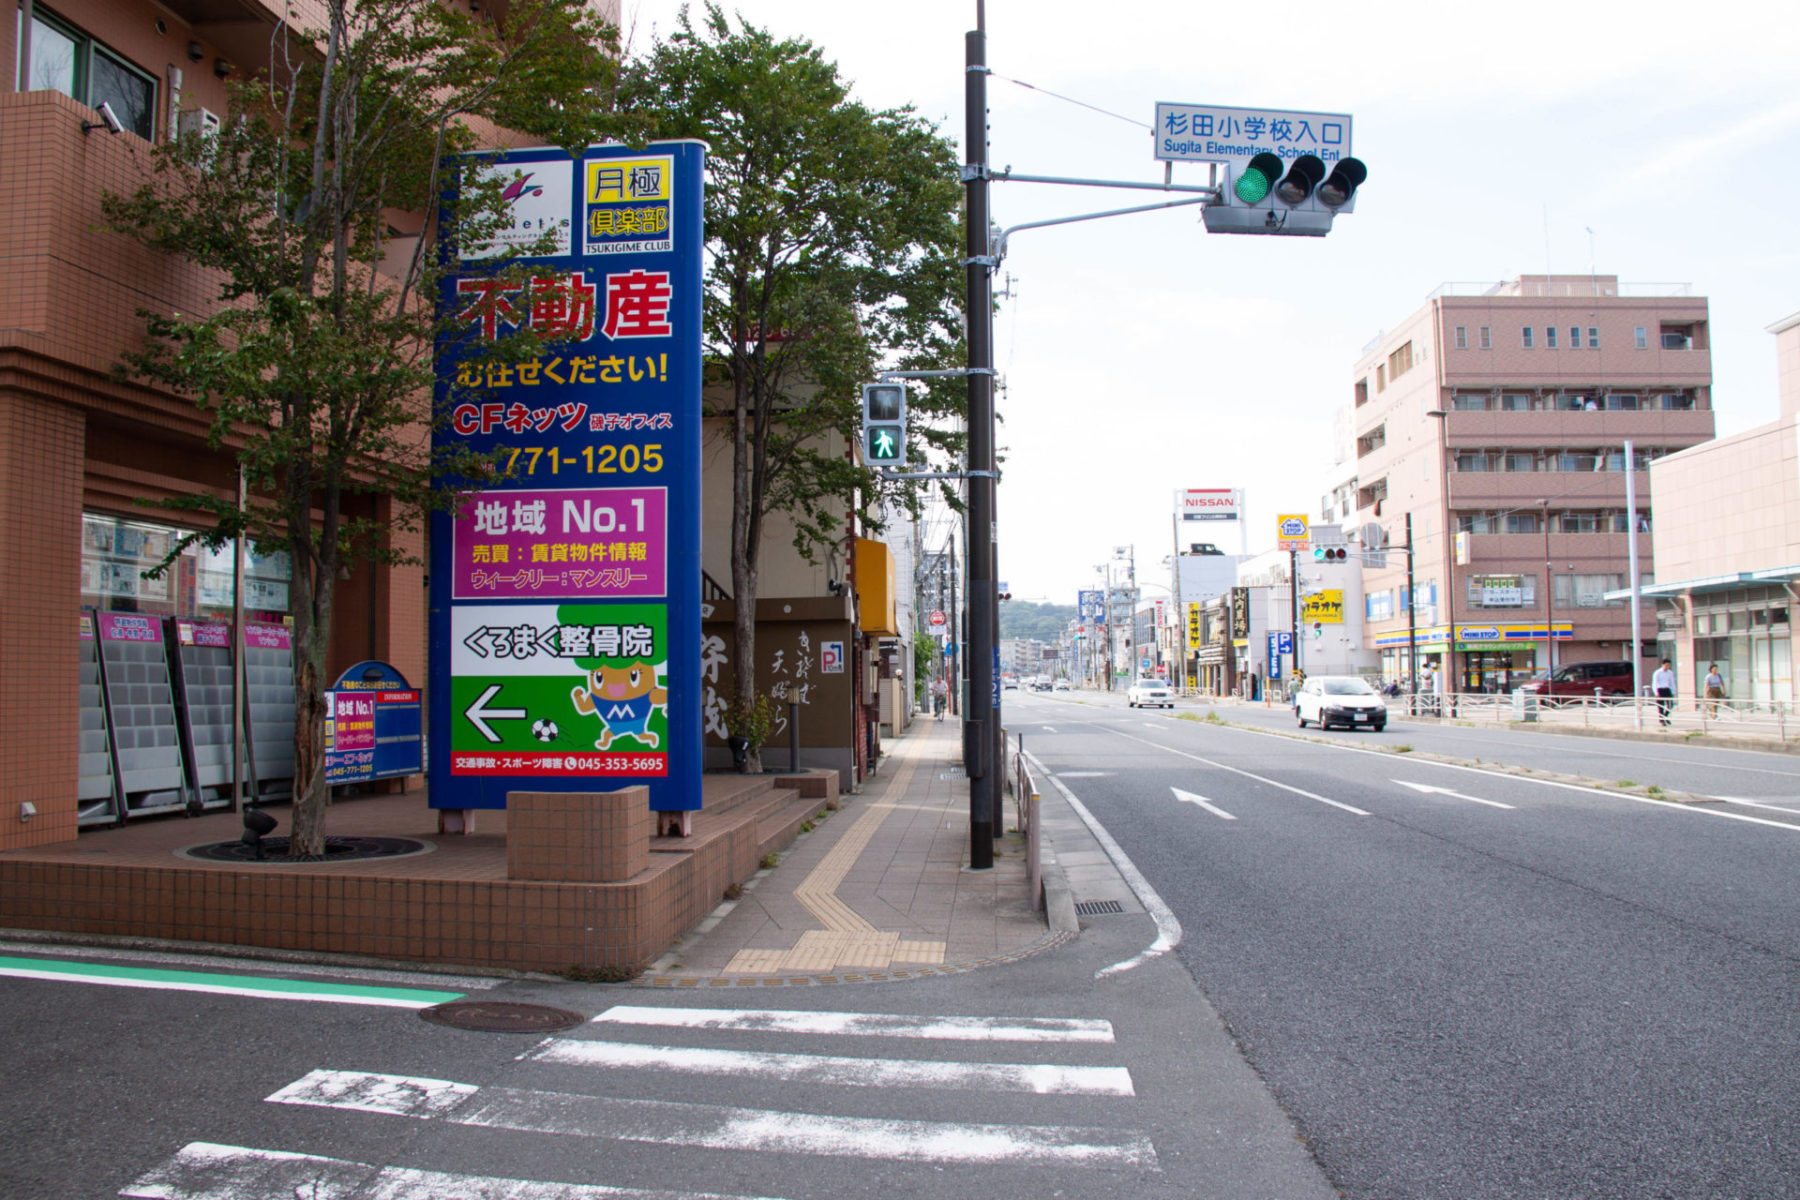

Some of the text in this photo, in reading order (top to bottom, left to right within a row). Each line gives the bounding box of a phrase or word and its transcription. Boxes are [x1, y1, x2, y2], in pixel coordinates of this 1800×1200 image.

[1165, 111, 1343, 145] 杉田小学校入口
[1164, 138, 1202, 156] Sugita
[1321, 148, 1340, 162] Ent
[594, 166, 661, 199] 月極
[589, 206, 668, 236] 倶楽部
[587, 240, 670, 254] TSUKIGIME CLUB
[456, 270, 673, 341] 不動産
[453, 402, 673, 435] CFネッツ 磯子オフィス
[1185, 498, 1234, 507] NISSAN
[474, 498, 645, 536] 地域 No.1
[1190, 608, 1200, 645] カラオケ
[1280, 633, 1290, 645] P
[1482, 631, 1498, 639] STOP
[463, 624, 654, 660] くろまく整骨院
[823, 652, 836, 671] P
[338, 700, 373, 716] 地域 No.1
[577, 757, 664, 771] 045-353-5695
